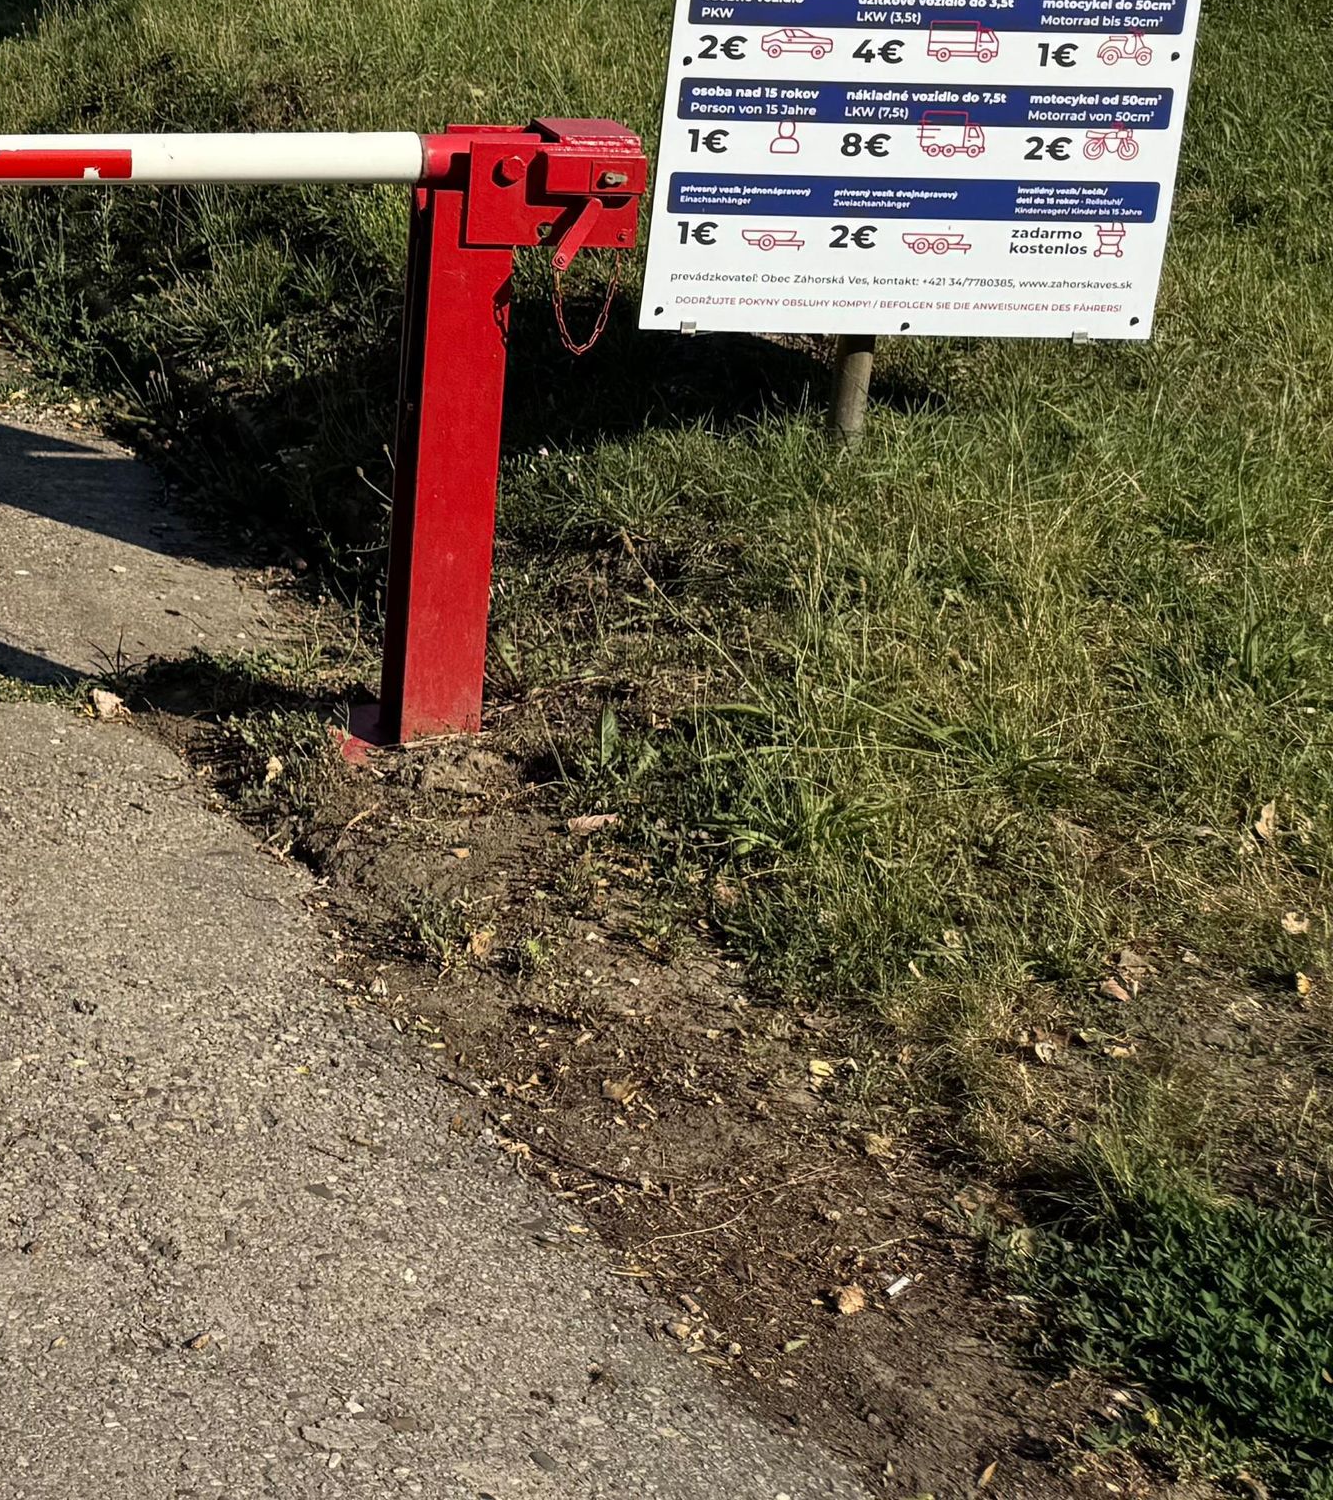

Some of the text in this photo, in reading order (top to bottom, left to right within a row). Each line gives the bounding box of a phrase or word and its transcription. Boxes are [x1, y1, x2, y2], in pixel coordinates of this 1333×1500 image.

[1043, 0, 1112, 11] motocykel
[1115, 0, 1132, 10] do
[702, 7, 734, 17] PKW
[857, 12, 921, 24] LKW (3,5t)
[1041, 15, 1099, 26] Motorrad
[1103, 16, 1120, 26] bis
[698, 35, 747, 60] 2€
[853, 39, 905, 64] 4€
[1038, 43, 1078, 67] 1€
[692, 86, 819, 99] osoba nad 15 rokov
[847, 90, 1006, 104] nákladné vozidlo do 7,5t
[1030, 94, 1099, 106] motocykel
[1102, 94, 1119, 105] od
[691, 102, 816, 115] Person von 15 Jahre
[845, 107, 908, 119] LKW (7,5t)
[1028, 110, 1086, 121] Motorrad
[688, 129, 729, 153] 1€
[841, 133, 891, 157] 8€
[1024, 137, 1072, 161] 2€
[680, 196, 751, 205] Einachsanhänger
[678, 222, 718, 245] 1€
[829, 225, 877, 249] 2€
[1012, 227, 1082, 239] zadarmo
[1010, 242, 1087, 254] kostenlos
[762, 274, 790, 283] Obec
[794, 275, 844, 284] Záhorská
[849, 277, 869, 285] Ves,
[873, 277, 918, 285] kontakt:
[973, 303, 1048, 311] ANWEISUNGEN
